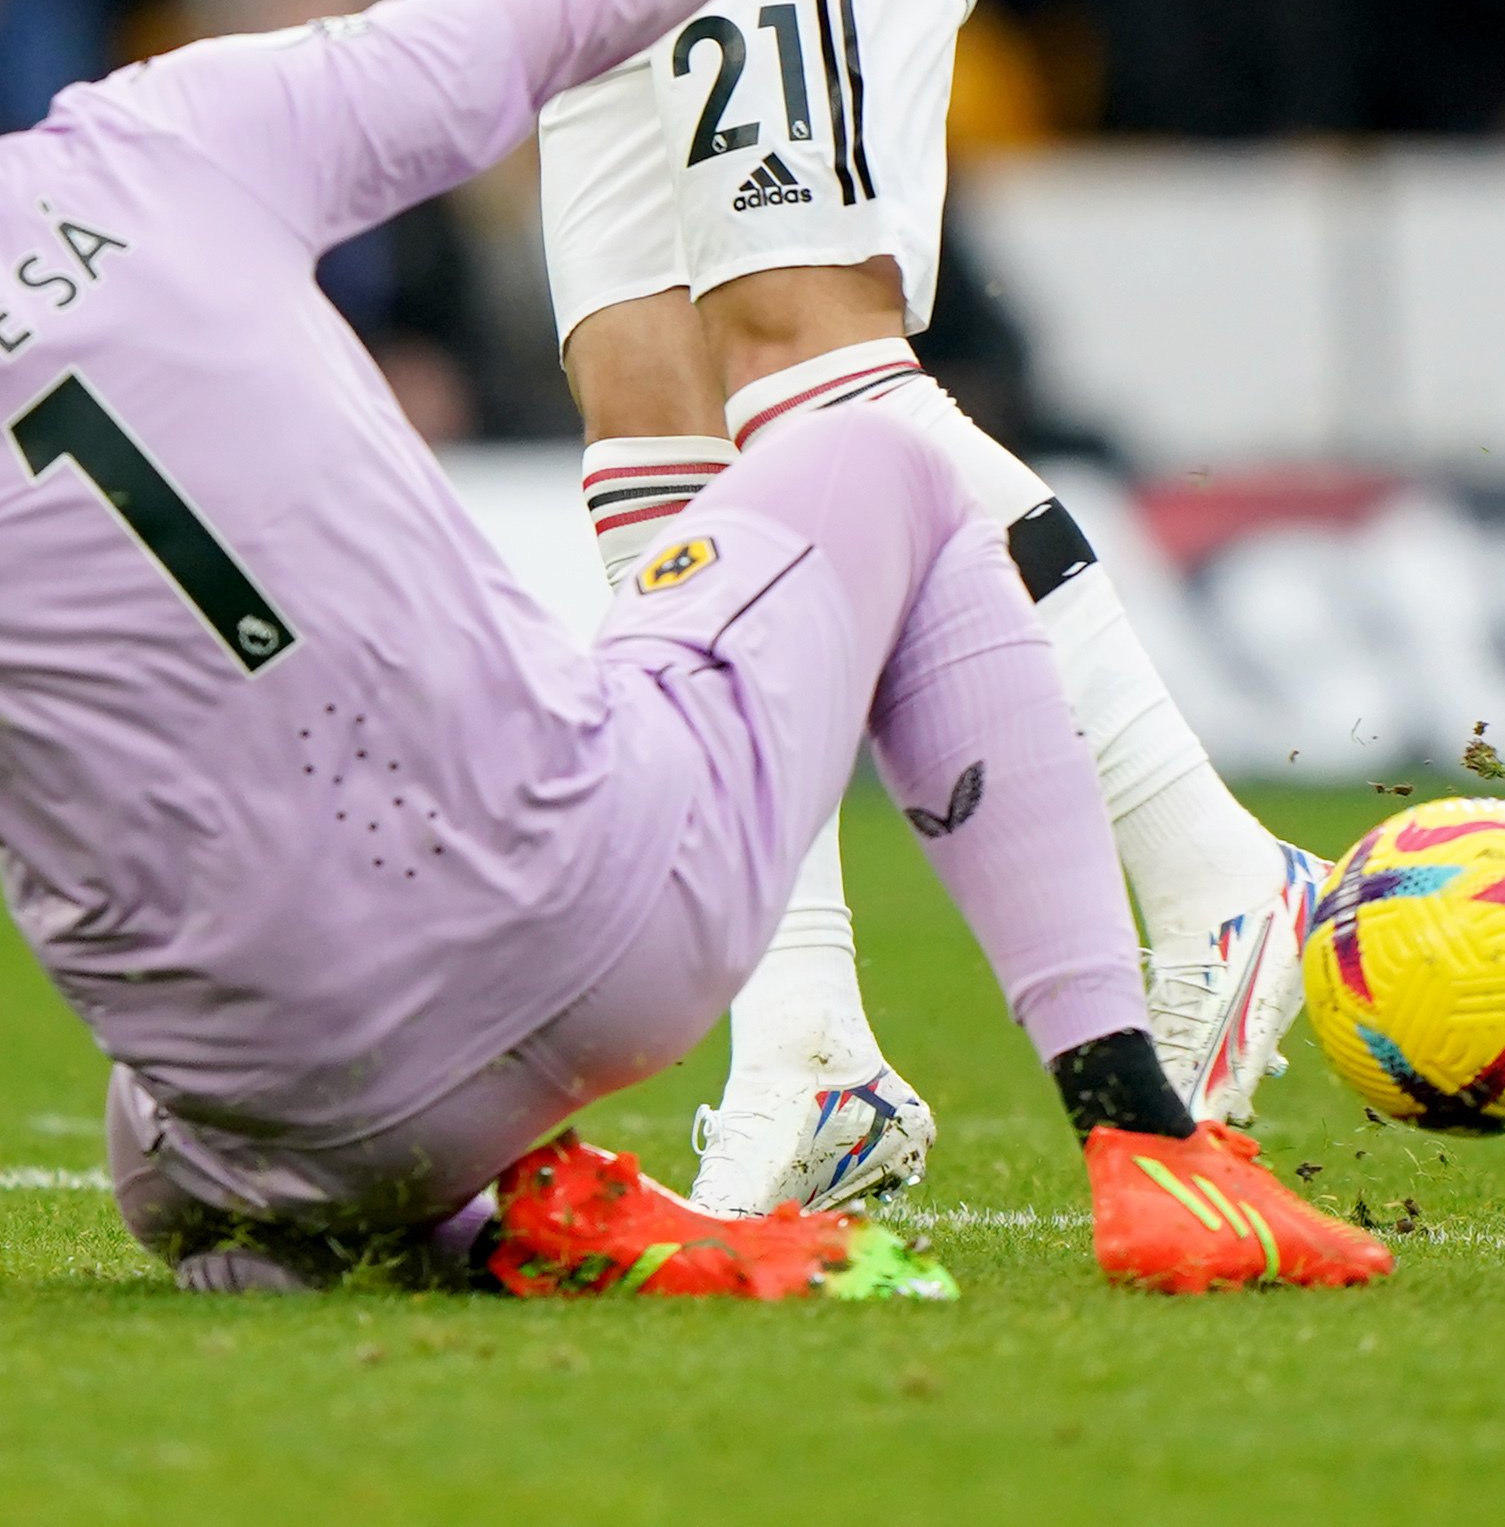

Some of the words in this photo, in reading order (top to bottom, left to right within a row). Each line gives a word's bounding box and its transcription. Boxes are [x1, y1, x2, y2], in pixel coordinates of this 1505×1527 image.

[672, 3, 813, 168] 21
[18, 200, 128, 308] SÁ
[732, 184, 813, 212] adidas
[7, 370, 301, 677] 1
